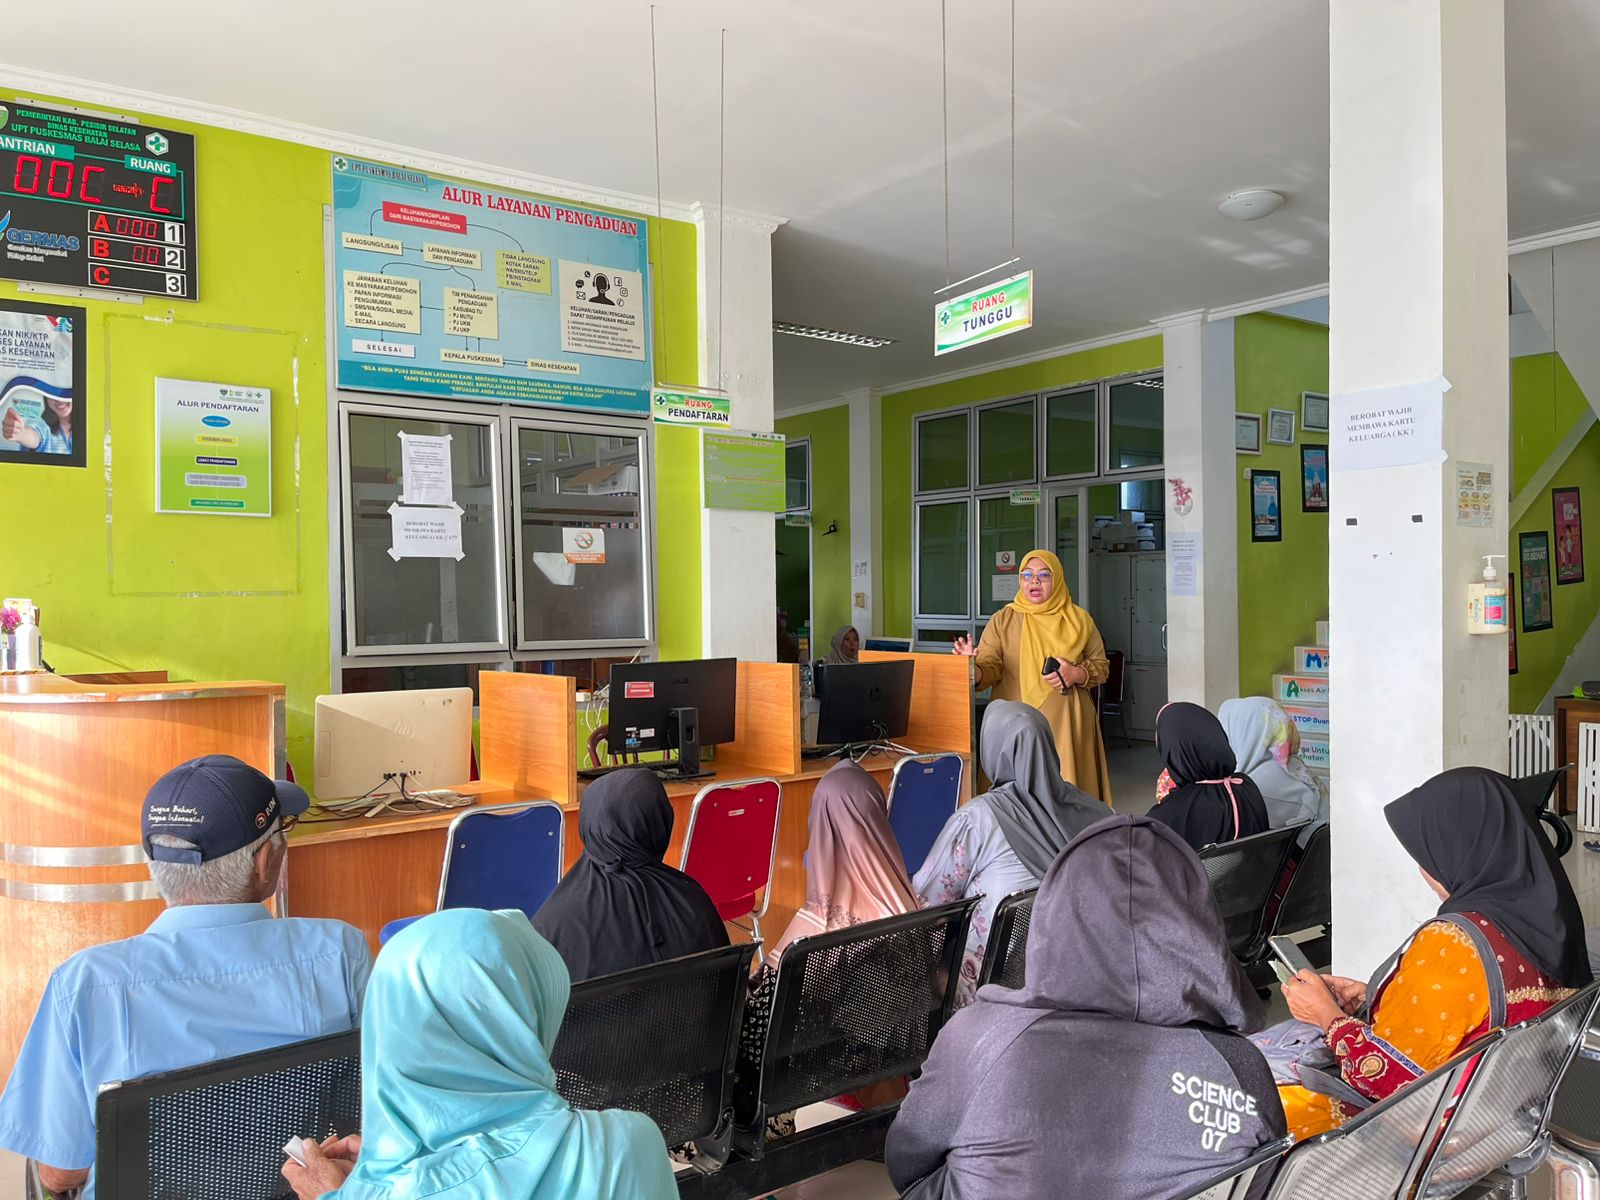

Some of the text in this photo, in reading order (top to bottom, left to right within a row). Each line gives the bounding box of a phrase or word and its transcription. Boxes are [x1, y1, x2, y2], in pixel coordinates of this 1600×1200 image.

[16, 109, 136, 136] PEMERINTAH KAB. PESISIR SELATAN
[48, 122, 108, 138] DINAS KESEHATAN
[12, 124, 141, 152] UPT PUSKESMAS BALAI SELASA
[0, 136, 55, 156] ANTRIAN
[130, 158, 170, 173] RUANG
[442, 186, 637, 236] ALUR LAYANAN PENGADUAN
[94, 214, 110, 232] A
[7, 228, 80, 250] GERMAS
[168, 225, 176, 242] 1
[94, 239, 110, 258] B
[346, 238, 399, 250] LANGSUNG/LISAN
[167, 251, 179, 267] 2
[428, 247, 476, 259] LAYANAN INFORMASI
[444, 256, 473, 264] PENGADUAN
[518, 256, 546, 264] LANGSUNG
[94, 267, 110, 284] C
[357, 275, 408, 286] JAWABAN KELUHAN
[168, 276, 180, 292] 3
[354, 296, 392, 306] PENGUMUMAN
[458, 299, 487, 308] PENGADUAN
[460, 292, 493, 302] PENANGANAN
[972, 292, 1004, 312] RUANG
[377, 320, 406, 328] LANGSUNG
[964, 306, 1012, 332] TUNGGU
[16, 330, 48, 340] NIK/KTP
[15, 340, 50, 349] LAYANAN
[367, 344, 402, 352] SELESAI
[9, 348, 54, 358] KESEHATAN
[466, 354, 500, 364] PUSKESMAS
[548, 363, 576, 372] KESEHATAN
[201, 402, 259, 412] PENDAFTARAN
[685, 400, 712, 408] RUANG
[668, 408, 728, 421] PENDAFTARAN
[1350, 407, 1412, 421] BEROBAT WAJIB
[1347, 418, 1416, 432] MEMBAWA KARTU
[1349, 431, 1392, 442] KELUARGA
[1312, 746, 1329, 754] Untu
[1171, 1072, 1258, 1116] SCIENCE
[1188, 1101, 1240, 1134] CLUB
[1202, 1128, 1228, 1152] 07
